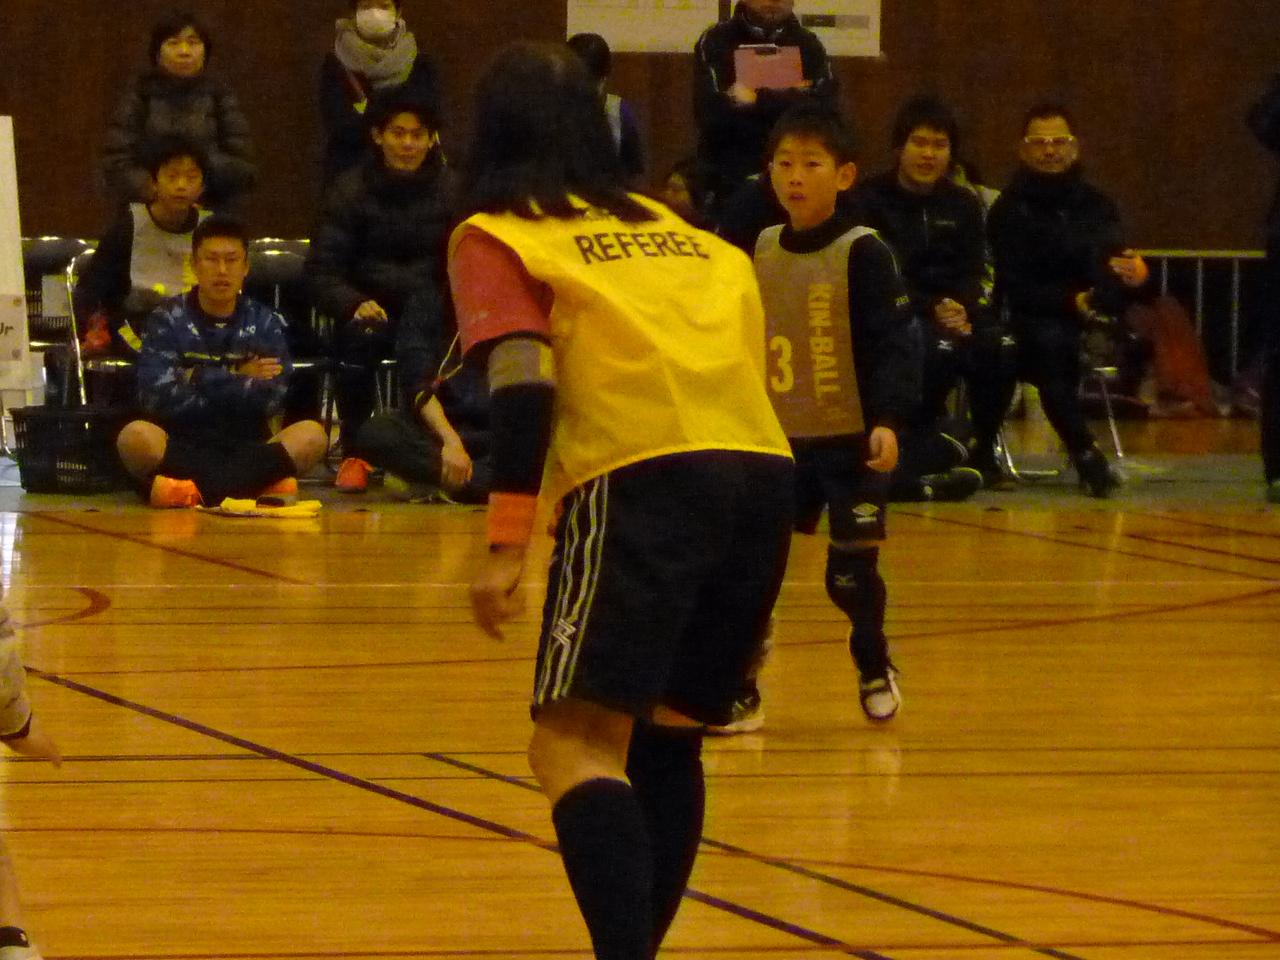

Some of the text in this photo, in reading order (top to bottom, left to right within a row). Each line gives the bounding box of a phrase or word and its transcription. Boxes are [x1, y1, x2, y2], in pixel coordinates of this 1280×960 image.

[574, 230, 710, 265] REFEREE
[769, 335, 795, 393] 3
[808, 283, 842, 399] KIN-BALL
